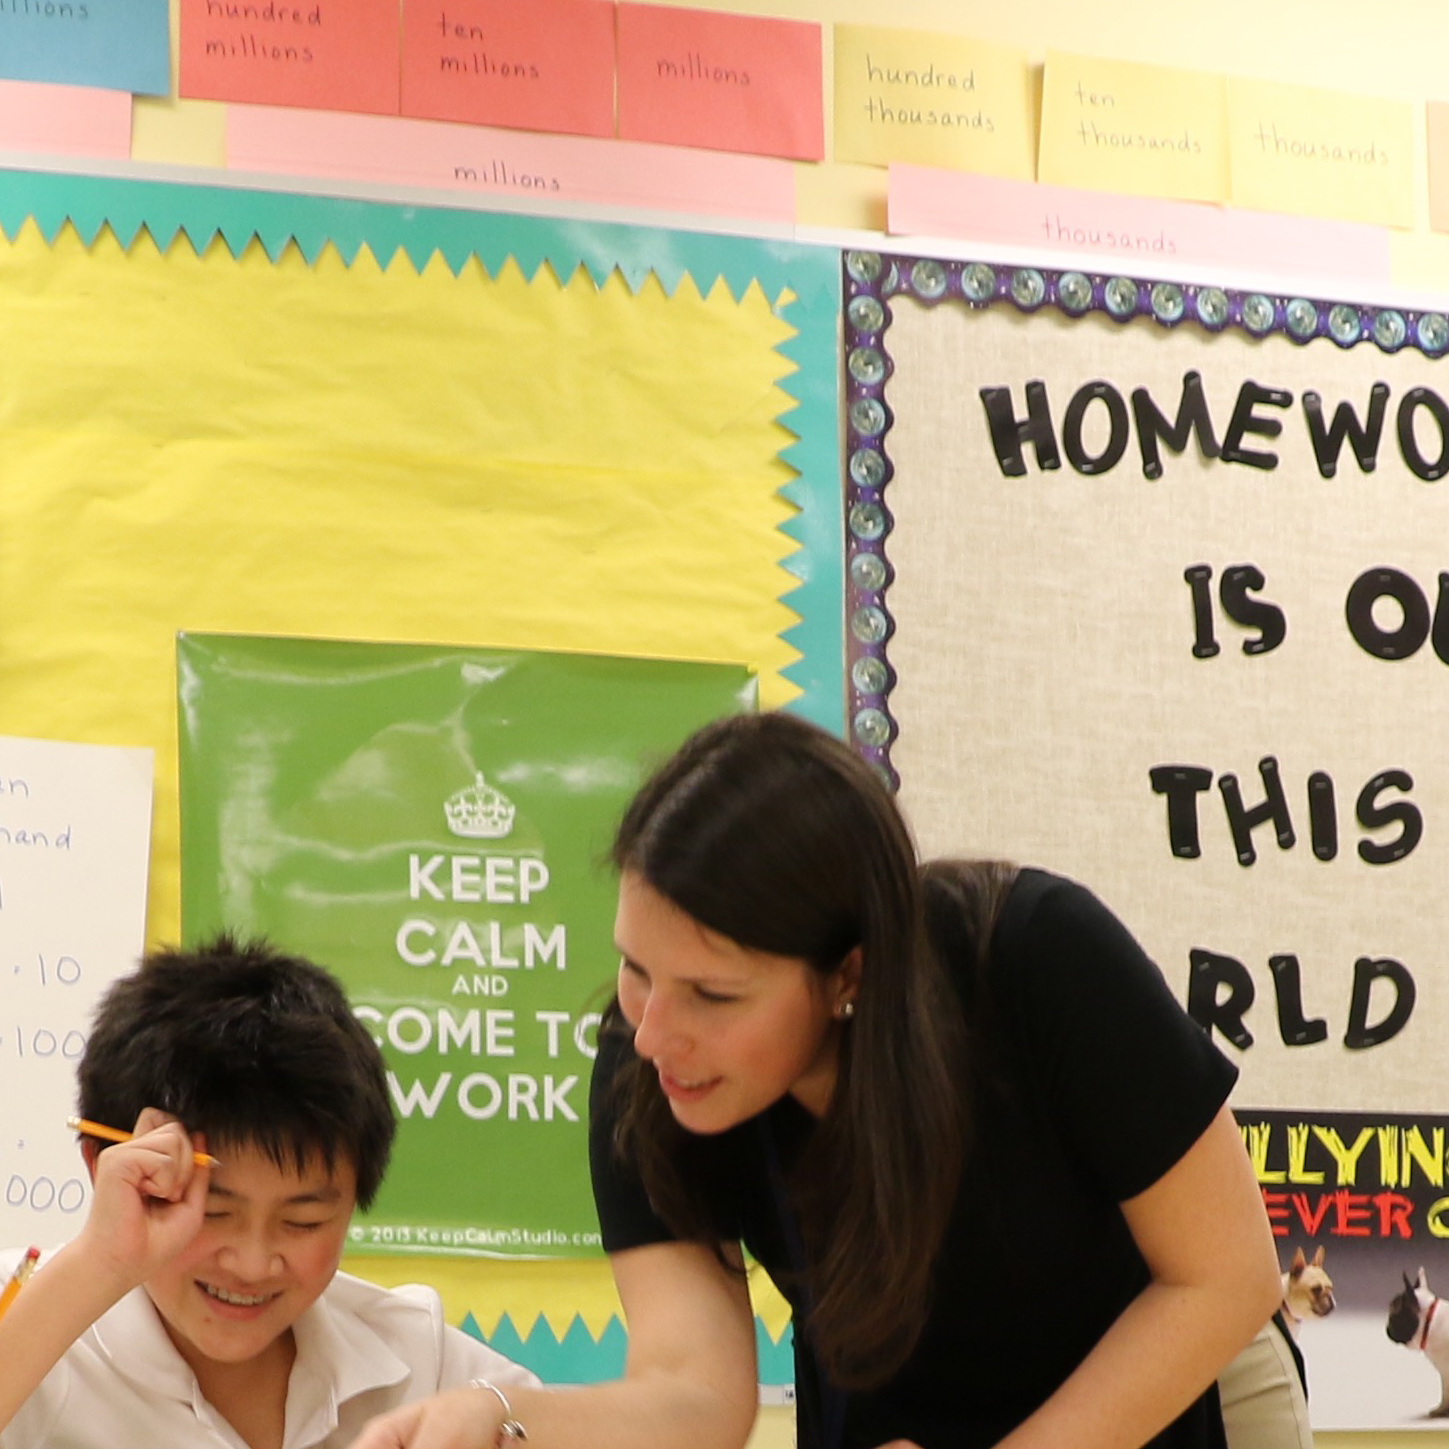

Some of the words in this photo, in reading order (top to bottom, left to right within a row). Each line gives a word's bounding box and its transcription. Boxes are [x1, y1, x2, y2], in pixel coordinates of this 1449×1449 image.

[207, 0, 321, 25] hundred
[437, 18, 484, 41] ten
[206, 34, 313, 62] millions
[440, 53, 540, 80] millions
[656, 55, 751, 87] millions
[866, 54, 976, 92] hundred
[1074, 80, 1115, 110] ten
[864, 96, 996, 135] thousands
[1077, 119, 1202, 156] thousands
[1253, 118, 1390, 167] thousands
[453, 163, 561, 192] millions
[1041, 216, 1178, 256] thousands
[1183, 564, 1288, 659] IS
[1149, 756, 1424, 867] THIS
[407, 854, 549, 904] KEEP
[395, 919, 568, 971] CALM
[38, 953, 82, 986] 10
[452, 975, 509, 998] AND
[16, 1026, 87, 1060] 100
[387, 1071, 579, 1122] WORK
